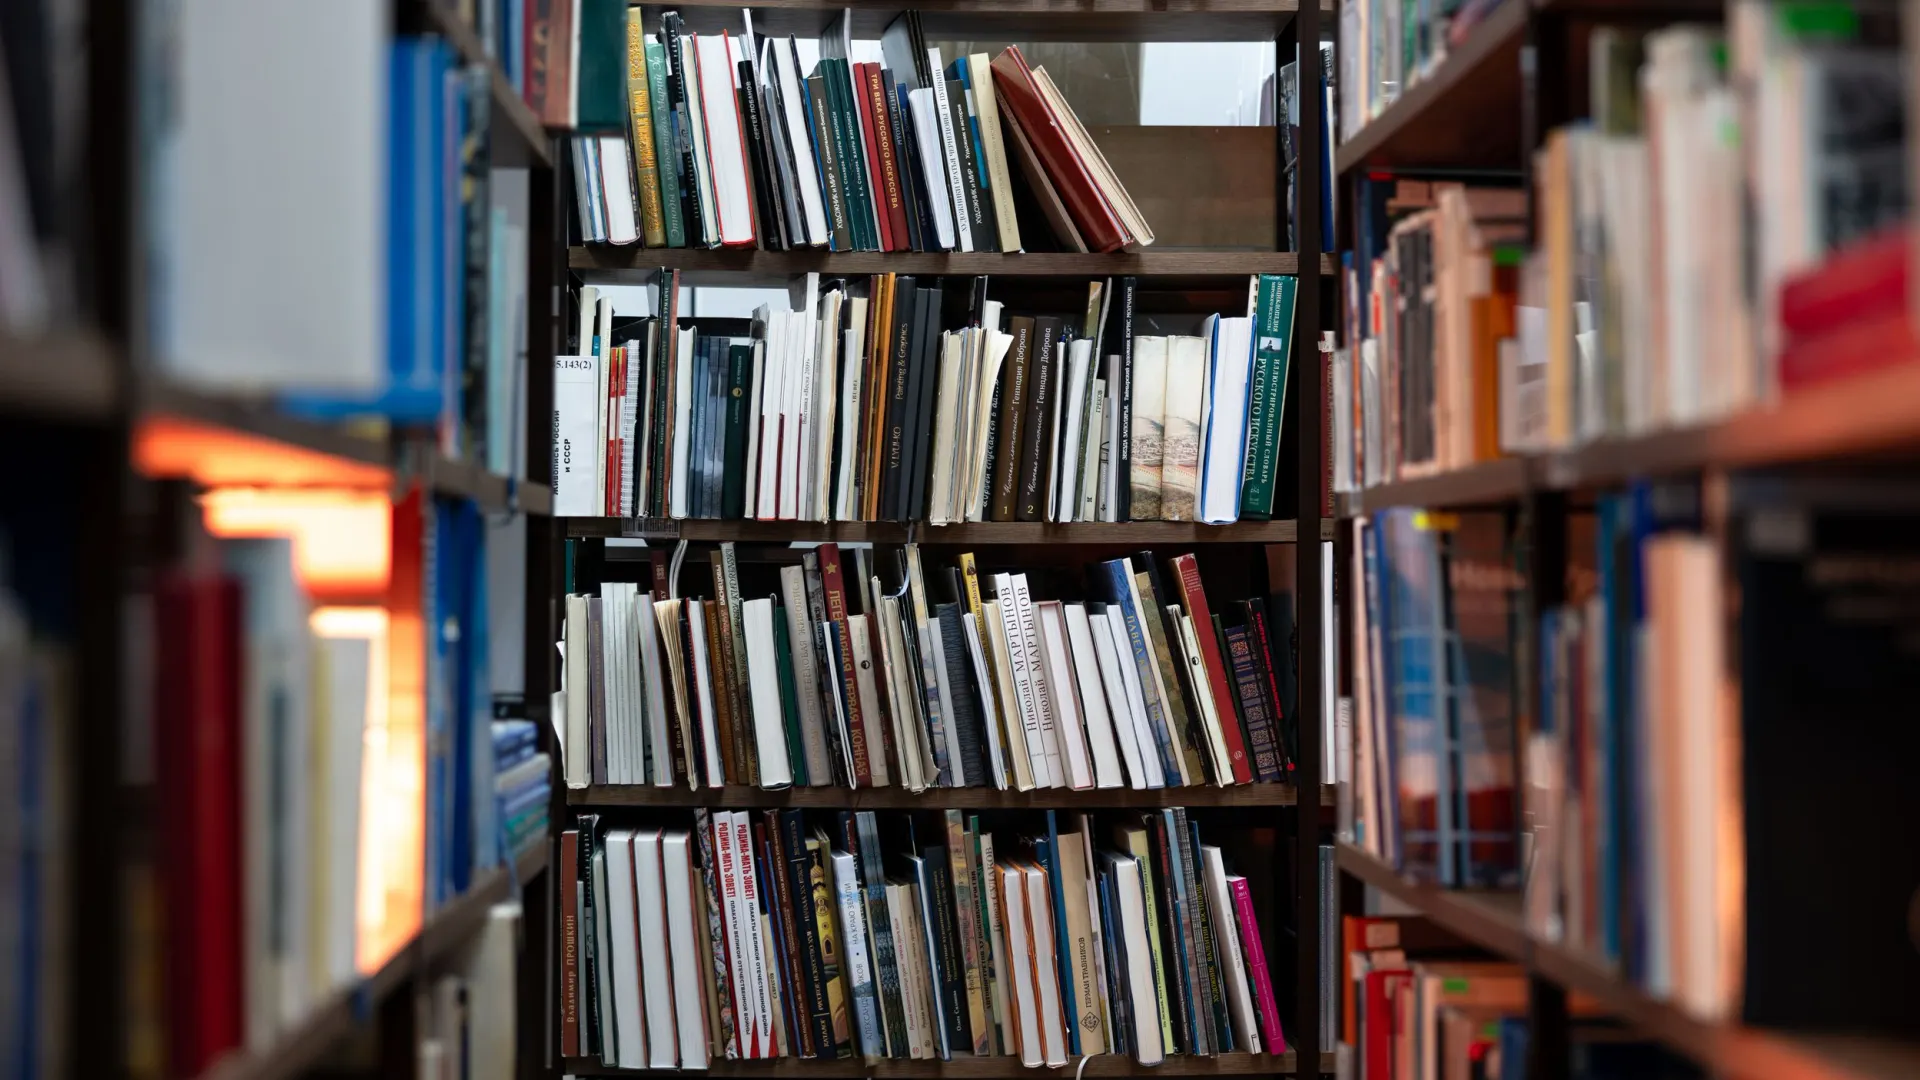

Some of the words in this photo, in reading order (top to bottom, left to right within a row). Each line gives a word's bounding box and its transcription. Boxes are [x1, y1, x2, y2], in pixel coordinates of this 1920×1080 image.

[655, 74, 666, 112] Марий
[745, 81, 757, 113] ЛОБАНОВ
[870, 74, 879, 89] ТРИ
[934, 68, 946, 101] ПУШКИН
[872, 92, 883, 113] ВЕКА
[750, 114, 761, 140] СЕРГЕЙ
[832, 111, 842, 140] ЖИВОПИСИ
[846, 111, 856, 140] ЖИВОПИСИ
[877, 115, 890, 158] РУССКОГО
[942, 113, 957, 157] ЧЕРНЕЦОВЫ
[659, 117, 675, 181] художниках
[962, 132, 971, 159] Художник
[828, 173, 837, 187] МИР
[884, 160, 898, 208] ИСКУССТВА
[948, 158, 961, 184] БРАТЬЯ
[967, 169, 976, 183] МИР
[667, 194, 680, 237] Этюды
[831, 193, 844, 229] ХУДОЖНИК
[954, 186, 968, 232] ХУДОЖНИКИ
[970, 188, 983, 224] ХУДОЖНИК
[1266, 306, 1274, 331] ИСКУССТВА
[1272, 281, 1284, 333] ЭНЦИКЛОПЕДИЯ
[899, 323, 909, 358] Graphics
[1016, 328, 1027, 364] Доброва
[1040, 327, 1052, 363] Доброва
[895, 368, 906, 400] Painting
[1012, 366, 1024, 404] Геннадия
[1036, 365, 1048, 404] Геннадия
[1251, 358, 1267, 415] РУССКОГО
[1265, 359, 1280, 447] ИЛЛЮСТРИРОВАННЫЙ
[985, 420, 996, 469] спускается
[1245, 418, 1262, 481] ИСКУССТВА
[1260, 449, 1272, 483] СЛОВАРЬ
[715, 564, 726, 606] ВАСНЕЦОВЫ
[829, 590, 852, 672] ЛЕГЕНДАРНАЯ
[1000, 587, 1026, 672] МАРТЫНОВ
[1017, 587, 1042, 671] МАРТЫНОВ
[1126, 615, 1143, 655] ПАВЕЛ
[845, 677, 858, 723] ПЕРВАЯ
[1020, 679, 1038, 731] Николай
[1037, 679, 1054, 731] Николай
[851, 729, 868, 776] КОННАЯ
[718, 822, 732, 873] РОДИНА-МАТЬ
[737, 824, 752, 874] РОДИНА-МАТЬ
[724, 874, 736, 898] ЗОВЕТ!
[743, 876, 755, 900] ЗОВЕТ!
[844, 883, 854, 910] ЗЕМЛИ
[730, 900, 739, 930] ПЛАКАТЫ
[749, 902, 757, 931] ПЛАКАТЫ
[848, 911, 857, 932] КРАЮ
[566, 915, 575, 966] ПРОШКИН
[734, 931, 742, 959] ВЕЛИКОЙ
[752, 932, 760, 960] ВЕЛИКОЙ
[851, 934, 859, 945] НА
[1078, 937, 1089, 979] ТРАВНИКОВ
[1202, 926, 1213, 962] ВАЛЕНТИН
[566, 971, 576, 1023] Владимир
[737, 961, 748, 1011] ОТЕЧЕСТВЕННОЙ
[755, 962, 766, 1013] ОТЕЧЕСТВЕННОЙ
[1083, 981, 1092, 1008] ГЕРМАН
[1208, 965, 1220, 1003] ХУДОЖНИК
[743, 1013, 751, 1035] ВОЙНЫ
[761, 1014, 770, 1037] ВОЙНЫ
[861, 996, 874, 1040] АЛЕКСАНДР
